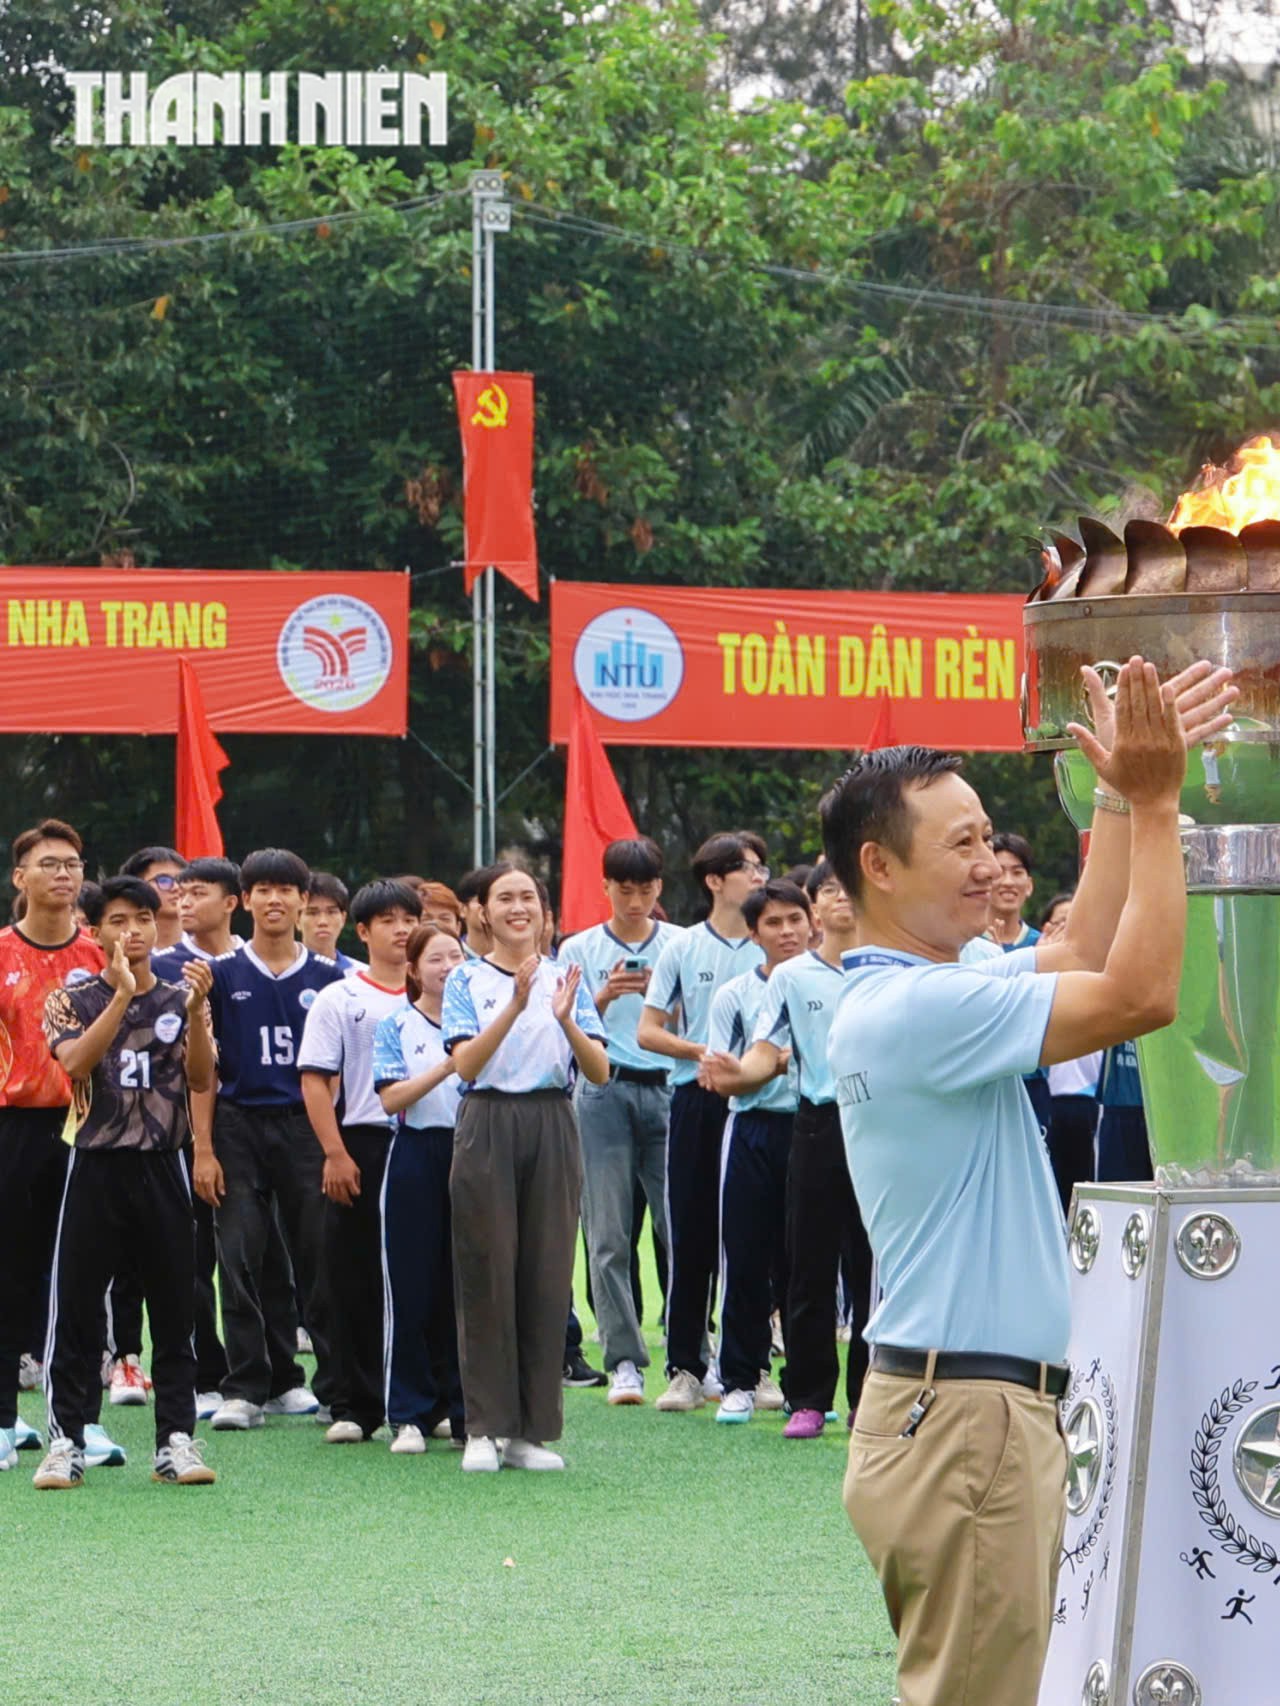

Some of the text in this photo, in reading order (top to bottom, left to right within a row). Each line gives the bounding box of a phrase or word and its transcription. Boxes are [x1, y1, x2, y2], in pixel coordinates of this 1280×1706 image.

[7, 600, 90, 648] NHA
[101, 601, 228, 649] TRANG
[600, 664, 658, 688] NTU
[717, 621, 1015, 700] TOÀN DÂN RÈN
[259, 1025, 294, 1065] 15
[120, 1049, 150, 1088] 21
